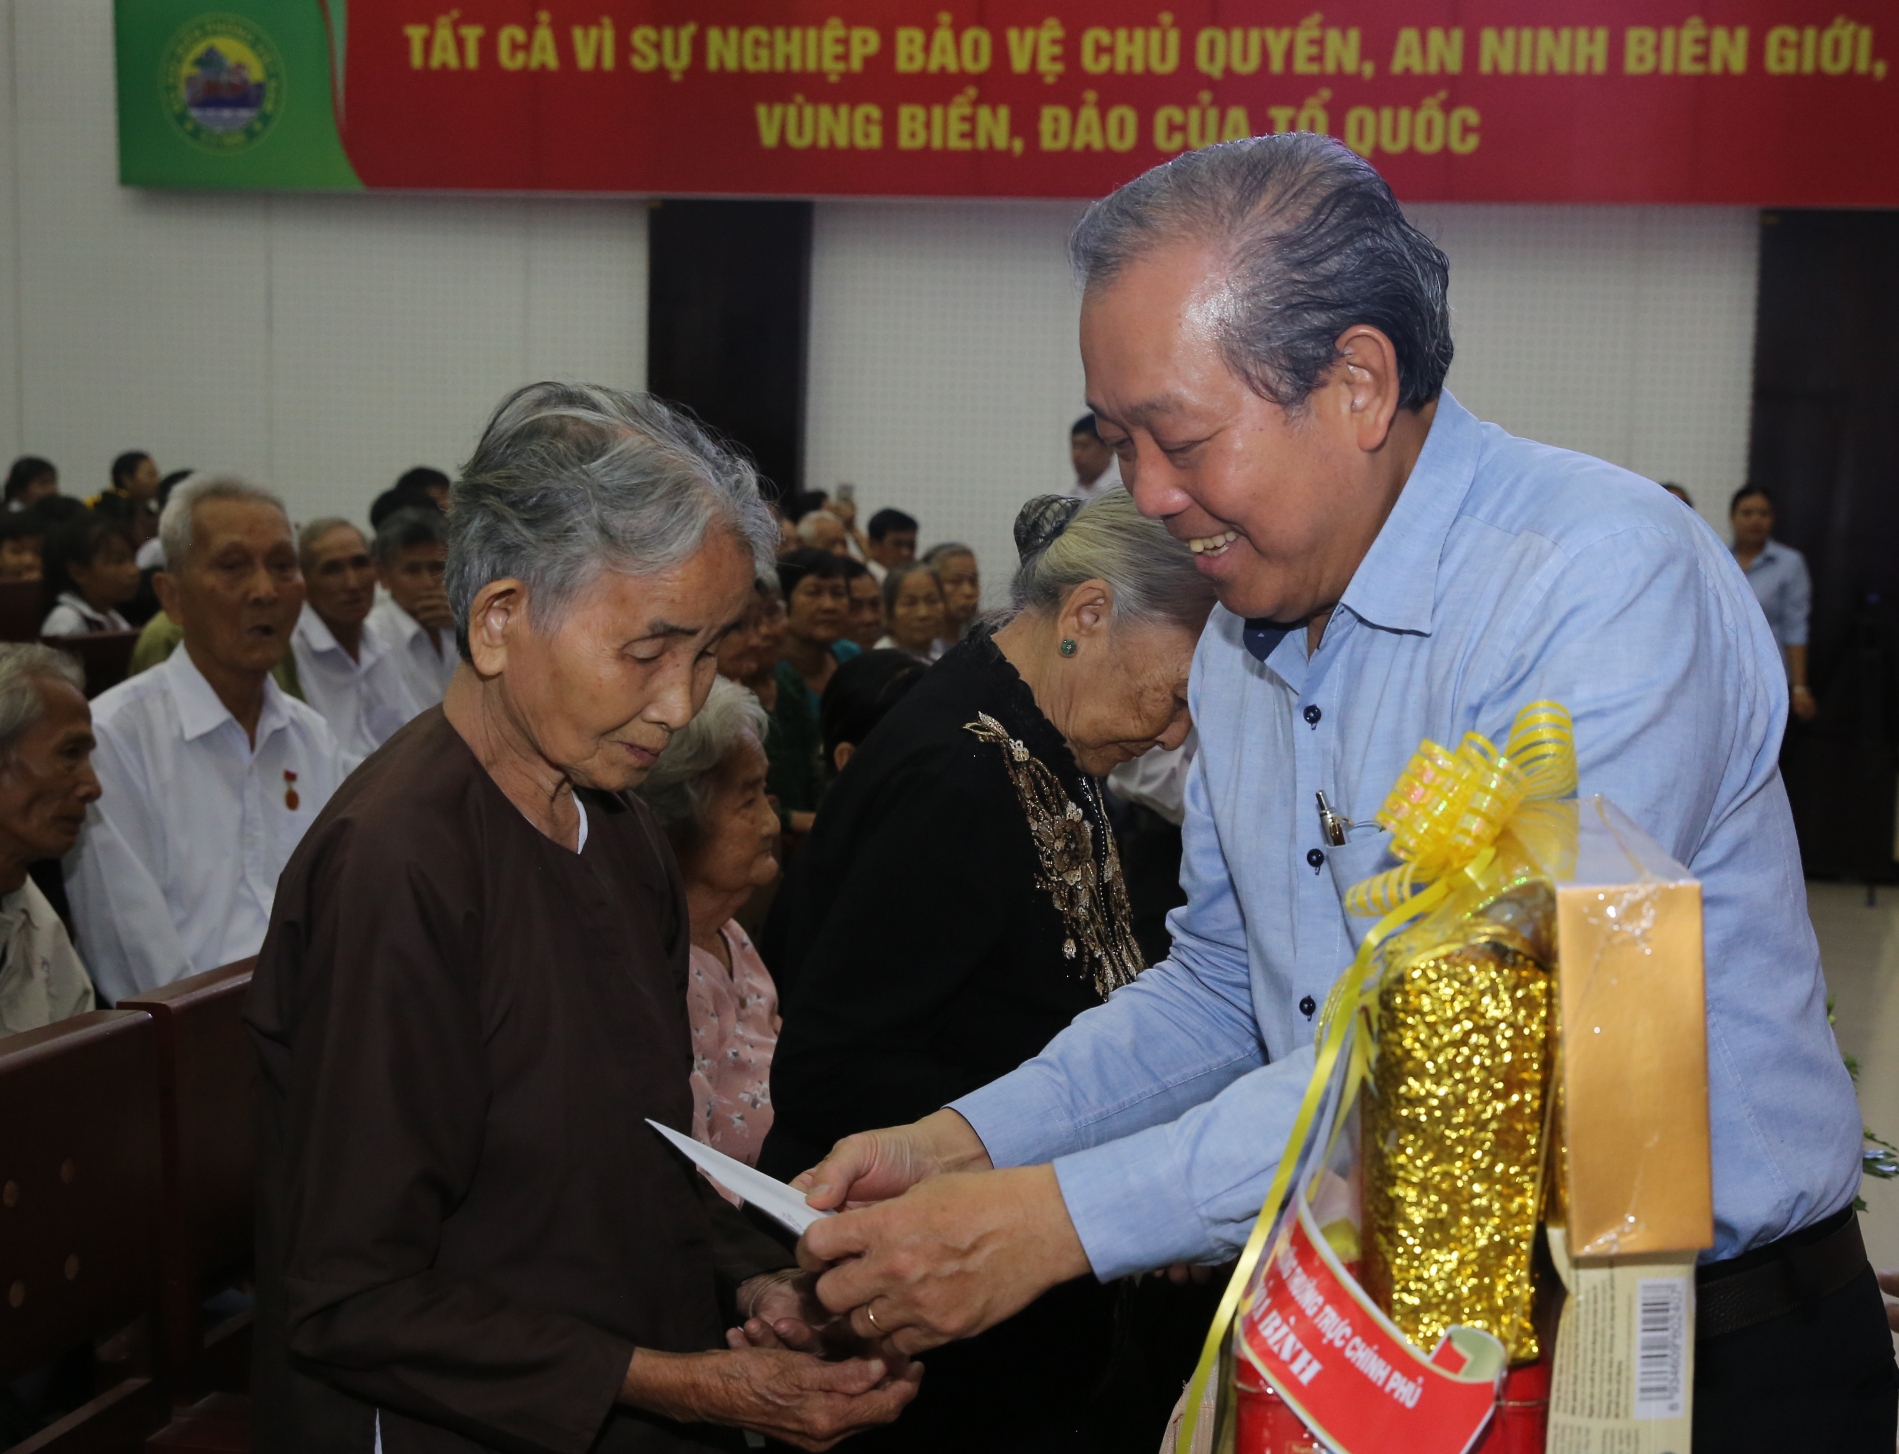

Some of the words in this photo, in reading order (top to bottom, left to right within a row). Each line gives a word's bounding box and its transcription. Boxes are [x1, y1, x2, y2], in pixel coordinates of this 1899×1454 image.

[404, 11, 485, 70] TẤT
[498, 11, 559, 70] CẢ
[572, 16, 616, 71] VÌ
[630, 22, 698, 81] SỰ
[706, 18, 880, 82] NGHIỆP
[895, 12, 992, 73] BẢO
[1007, 18, 1065, 83] VỆ
[1081, 13, 1179, 74] CHỦ
[1195, 13, 1375, 79] QUYỀN,
[1391, 27, 1463, 73] AN
[1480, 27, 1608, 74] NINH
[1624, 17, 1748, 74] BIÊN
[1764, 17, 1886, 78] GIỚI,
[755, 94, 882, 150] VÙNG
[897, 87, 1023, 154] BIỂN,
[1039, 91, 1137, 152] ĐẢO
[1154, 91, 1250, 152] CỦA
[1345, 90, 1480, 158] QUỐC
[1258, 1309, 1323, 1386] BÌNH
[1344, 1335, 1393, 1387] CHÍNH
[1384, 1370, 1424, 1409] PHỦ
